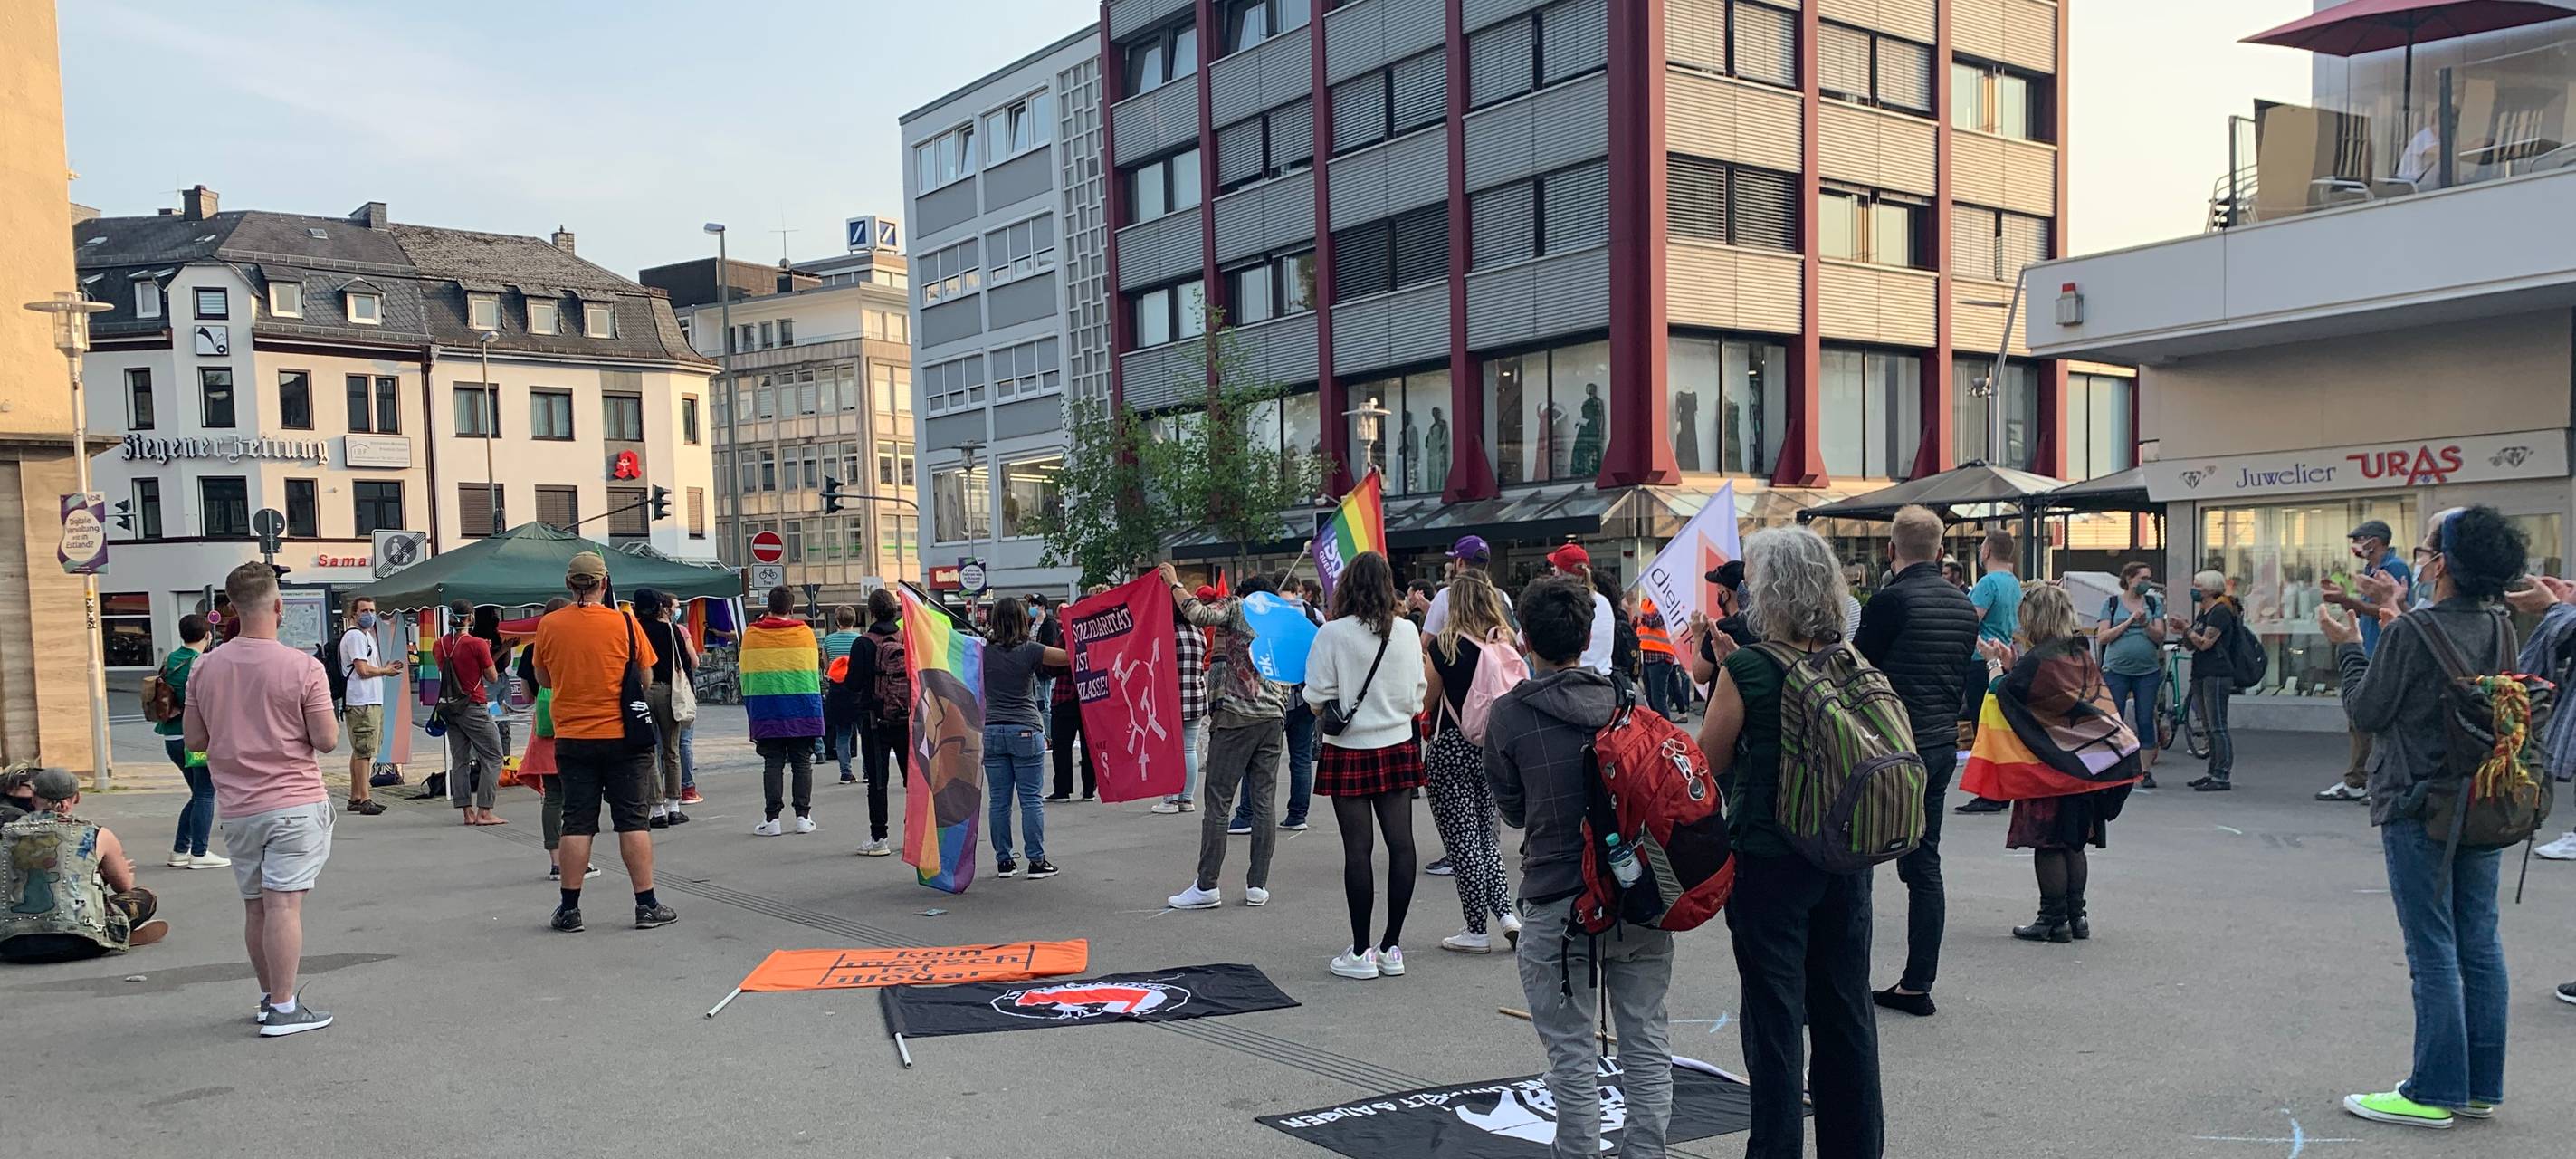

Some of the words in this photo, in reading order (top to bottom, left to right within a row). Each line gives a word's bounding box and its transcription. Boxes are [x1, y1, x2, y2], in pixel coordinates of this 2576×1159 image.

[121, 433, 224, 465] Siegener
[227, 433, 330, 465] Zeitung
[2236, 463, 2336, 488] Juwelier
[2346, 445, 2464, 486] URAS
[318, 554, 372, 567] Sama
[1072, 607, 1132, 643] SOLIDARITÄT
[1075, 651, 1089, 673] IST
[1077, 675, 1109, 701] KLASSE!
[845, 955, 1018, 968] mensch
[897, 949, 982, 958] kein
[881, 963, 932, 973] ist
[1279, 1101, 1397, 1129] SAUBER
